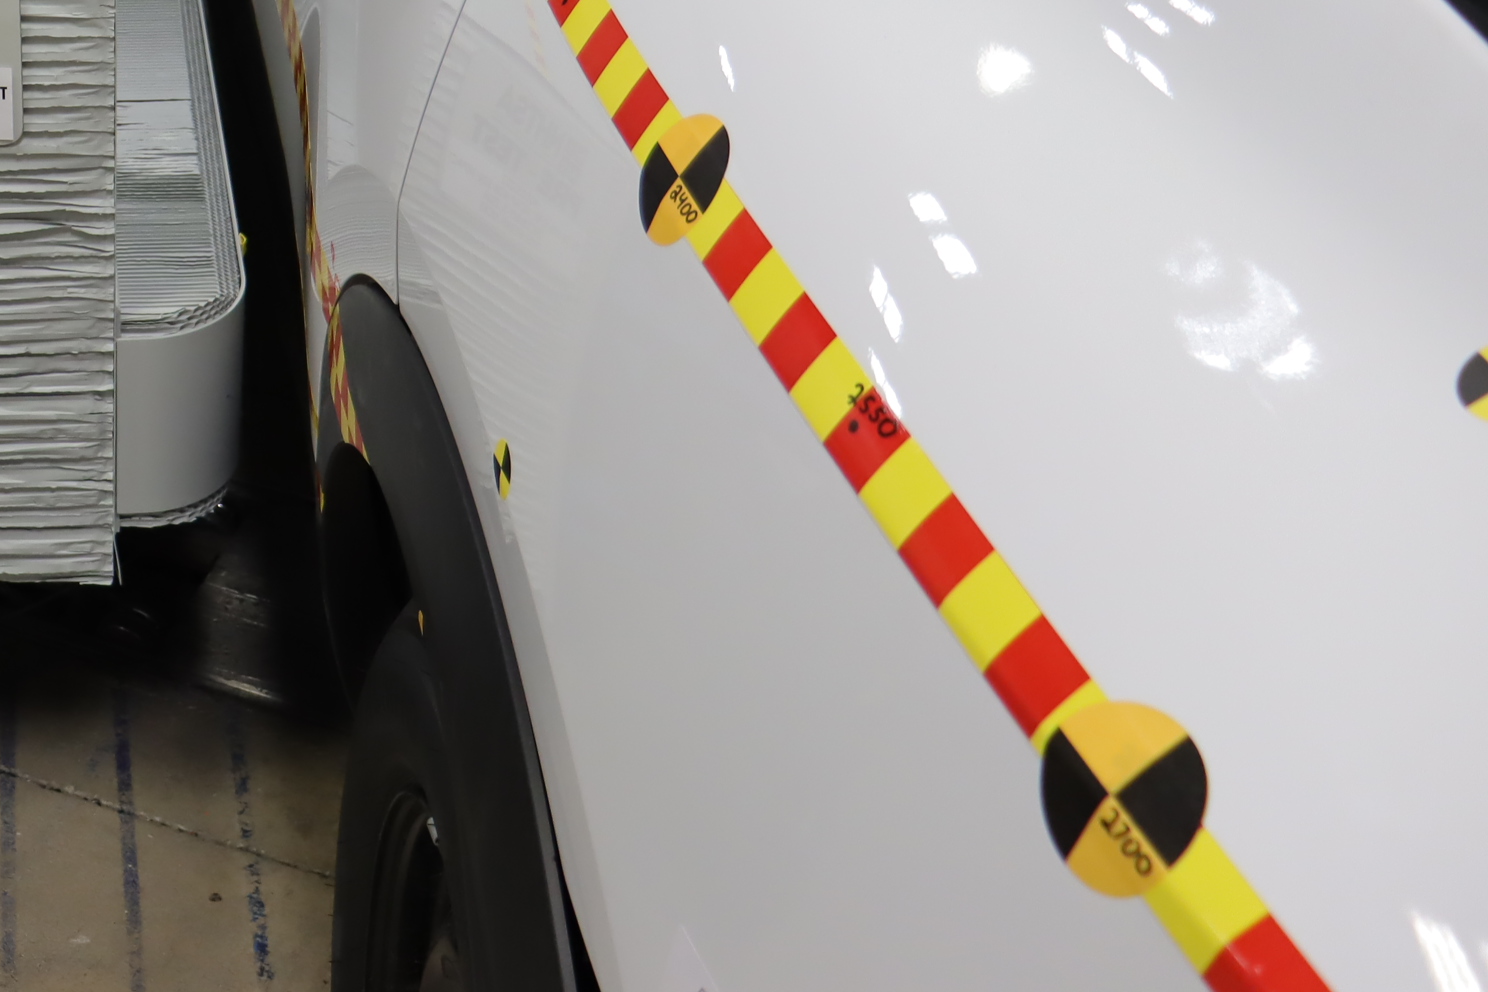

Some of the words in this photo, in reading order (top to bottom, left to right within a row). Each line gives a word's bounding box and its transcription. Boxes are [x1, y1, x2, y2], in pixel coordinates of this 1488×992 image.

[669, 184, 699, 224] 2400
[847, 382, 898, 439] 2550
[1100, 807, 1152, 878] 2700
